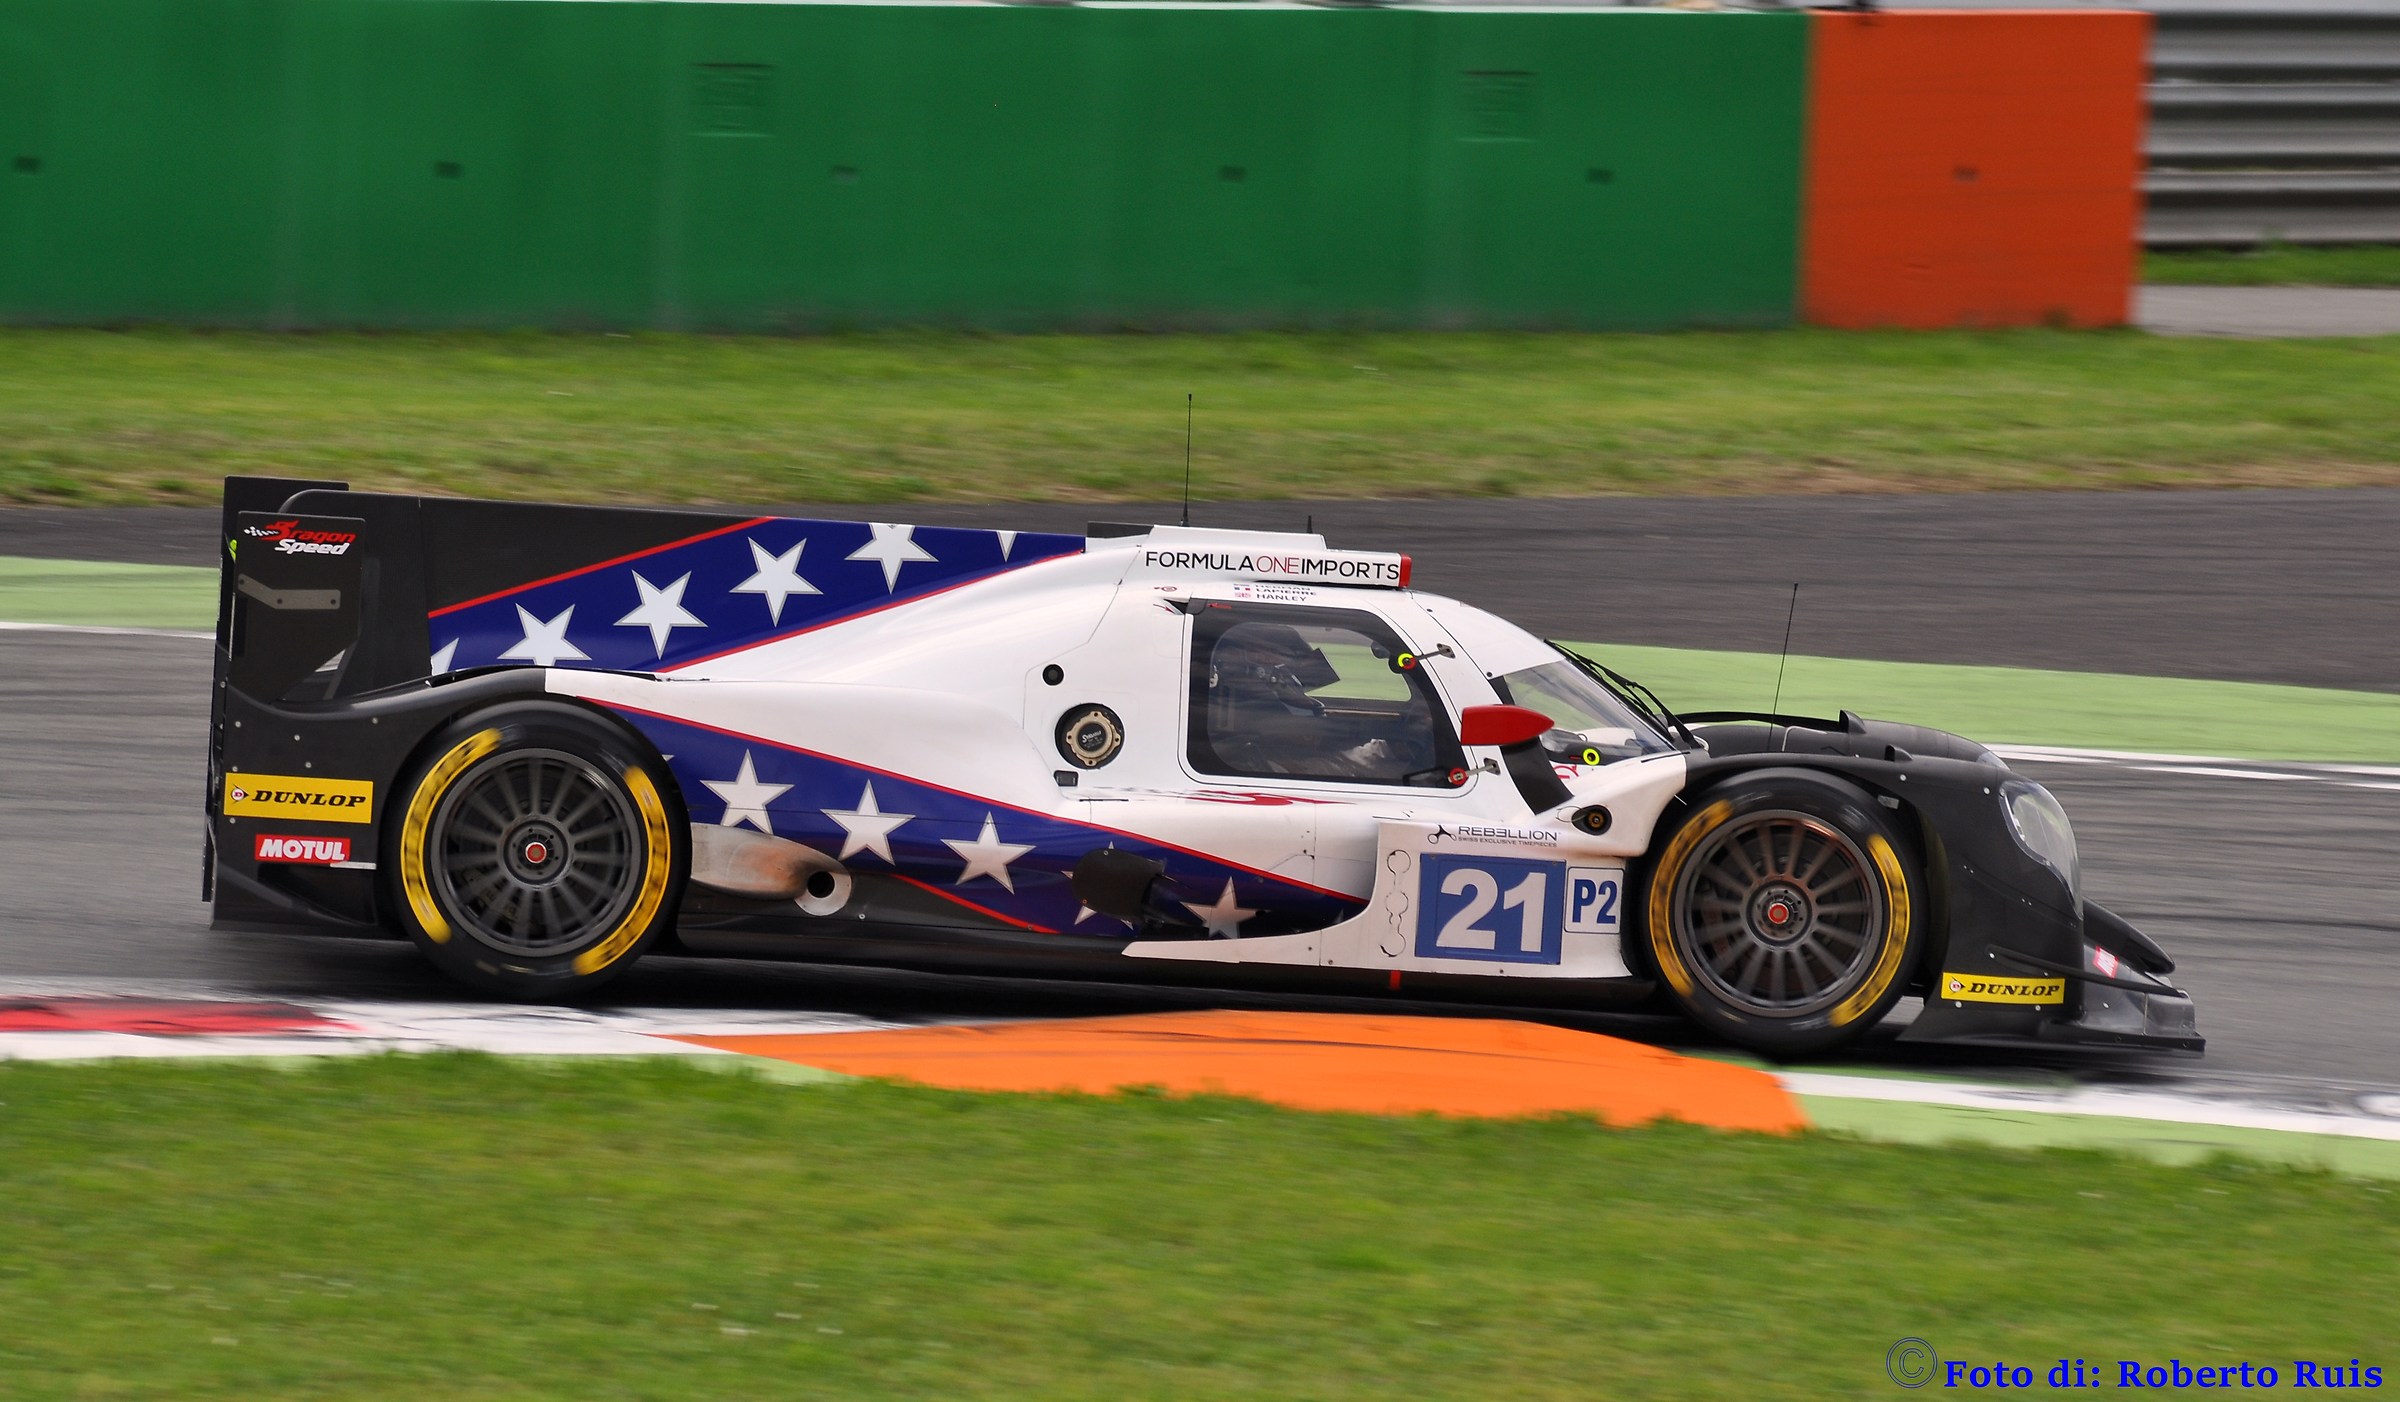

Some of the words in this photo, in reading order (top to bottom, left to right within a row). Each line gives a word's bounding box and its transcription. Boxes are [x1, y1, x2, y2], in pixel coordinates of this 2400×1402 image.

[274, 538, 350, 555] Speed
[1256, 593, 1307, 602] HANLEY
[251, 790, 367, 808] DUNLOP
[258, 838, 345, 861] MOTUL
[1436, 868, 1547, 953] 21
[1572, 878, 1619, 925] P2
[1968, 982, 2060, 996] DUNLOP
